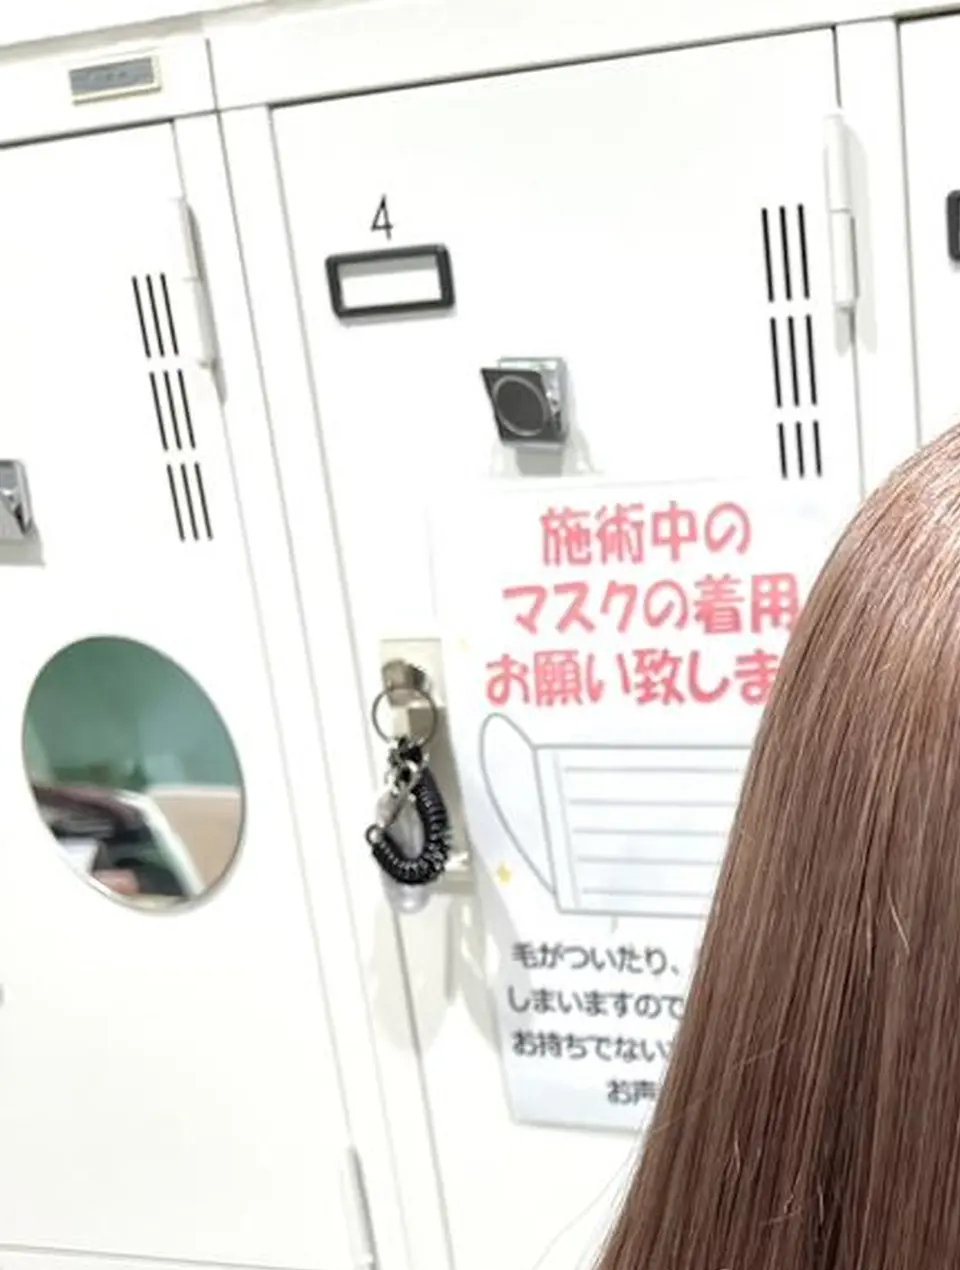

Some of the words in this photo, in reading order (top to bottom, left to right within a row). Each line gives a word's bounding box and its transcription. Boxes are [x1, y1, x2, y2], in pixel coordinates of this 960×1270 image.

[370, 194, 394, 240] 4
[540, 501, 752, 566] 施術中の
[502, 573, 799, 635] マスクの着用
[485, 648, 778, 707] お願い致しま
[511, 942, 680, 975] 毛がついたり、
